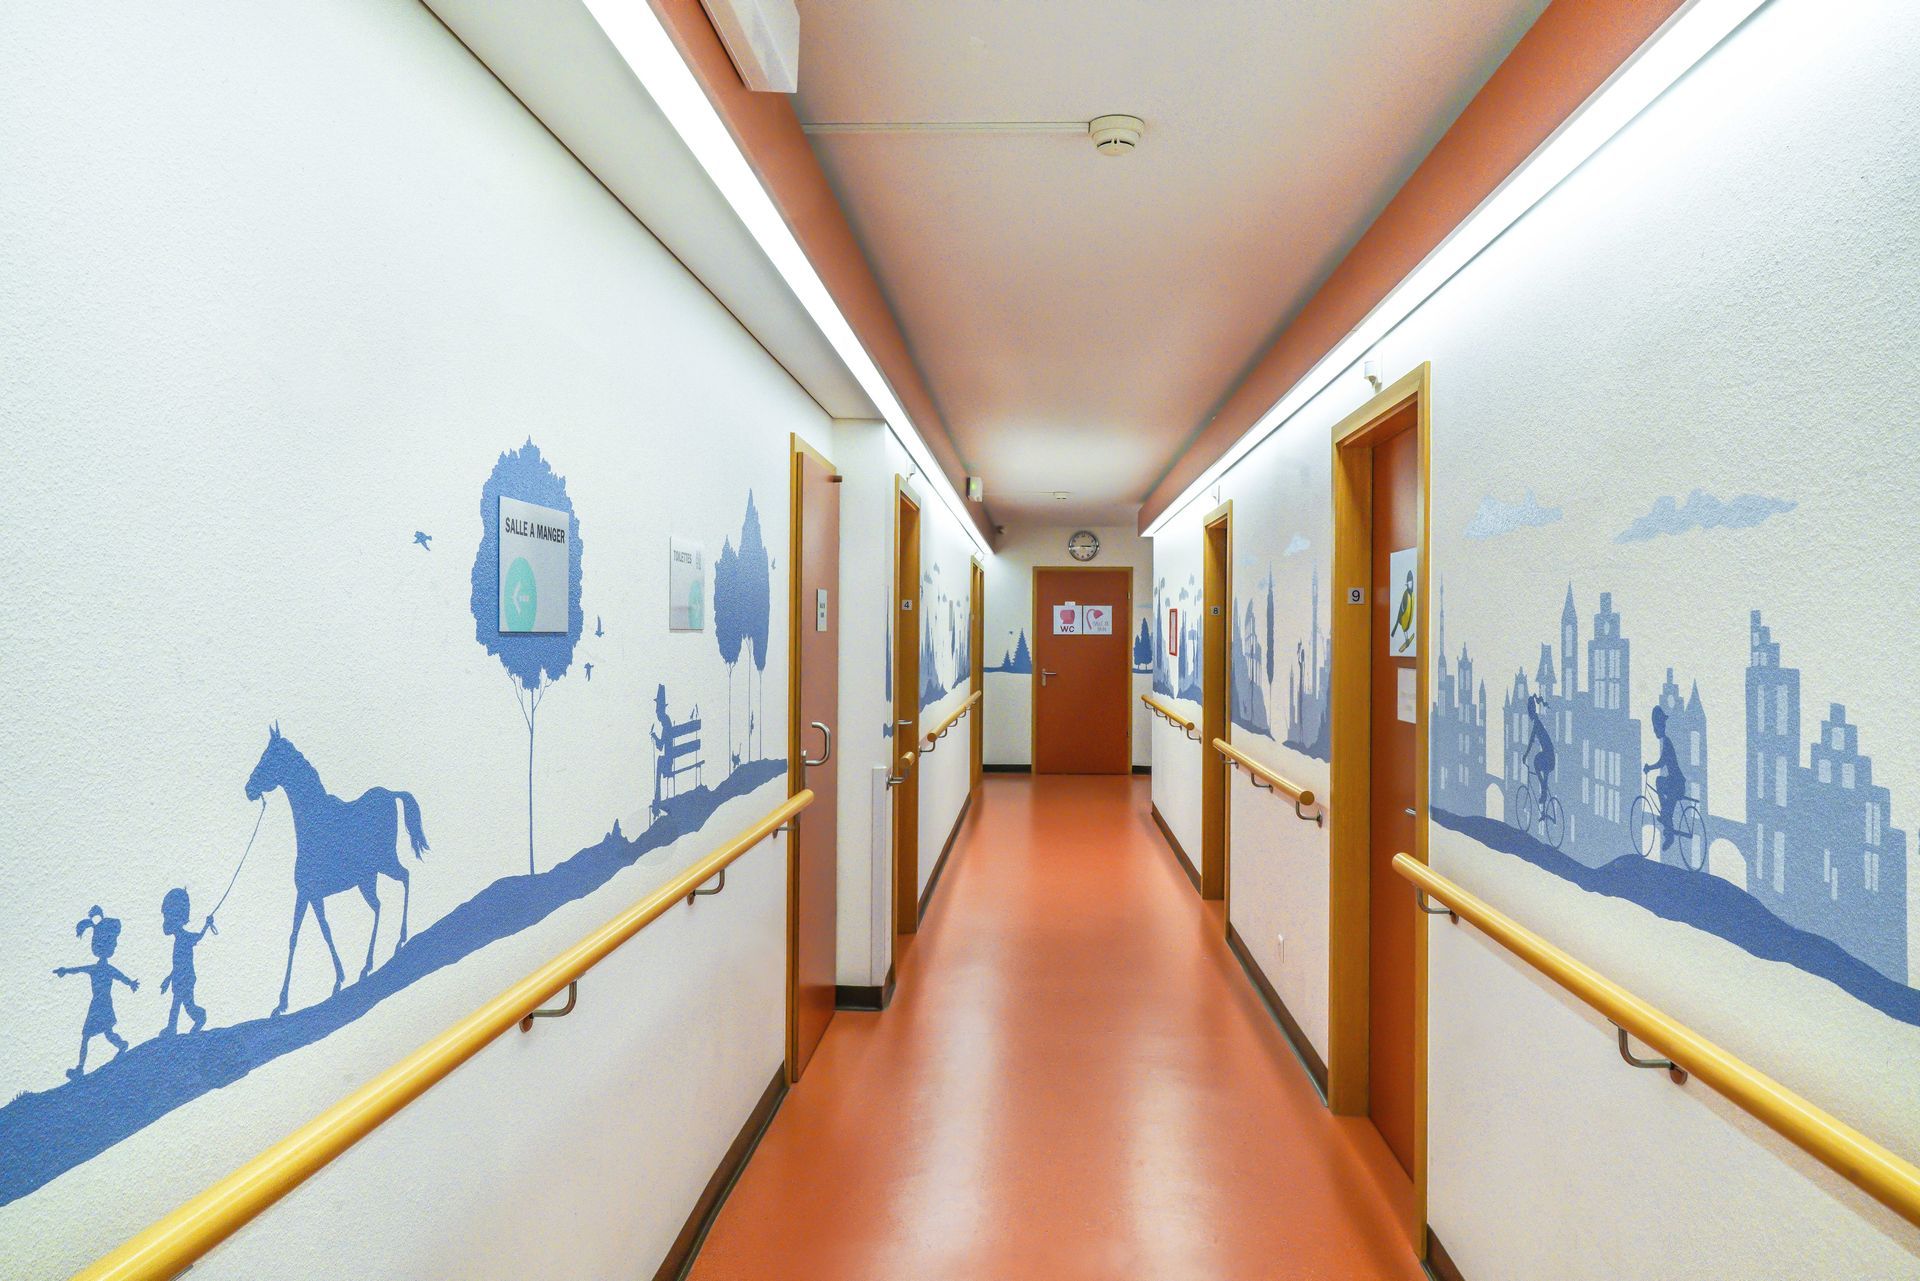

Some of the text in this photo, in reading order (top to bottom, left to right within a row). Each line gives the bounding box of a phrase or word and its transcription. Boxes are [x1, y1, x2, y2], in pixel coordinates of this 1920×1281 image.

[505, 517, 565, 543] SALLE A MANGER
[1351, 589, 1360, 602] 9
[903, 601, 910, 609] 4
[1060, 625, 1075, 633] WC
